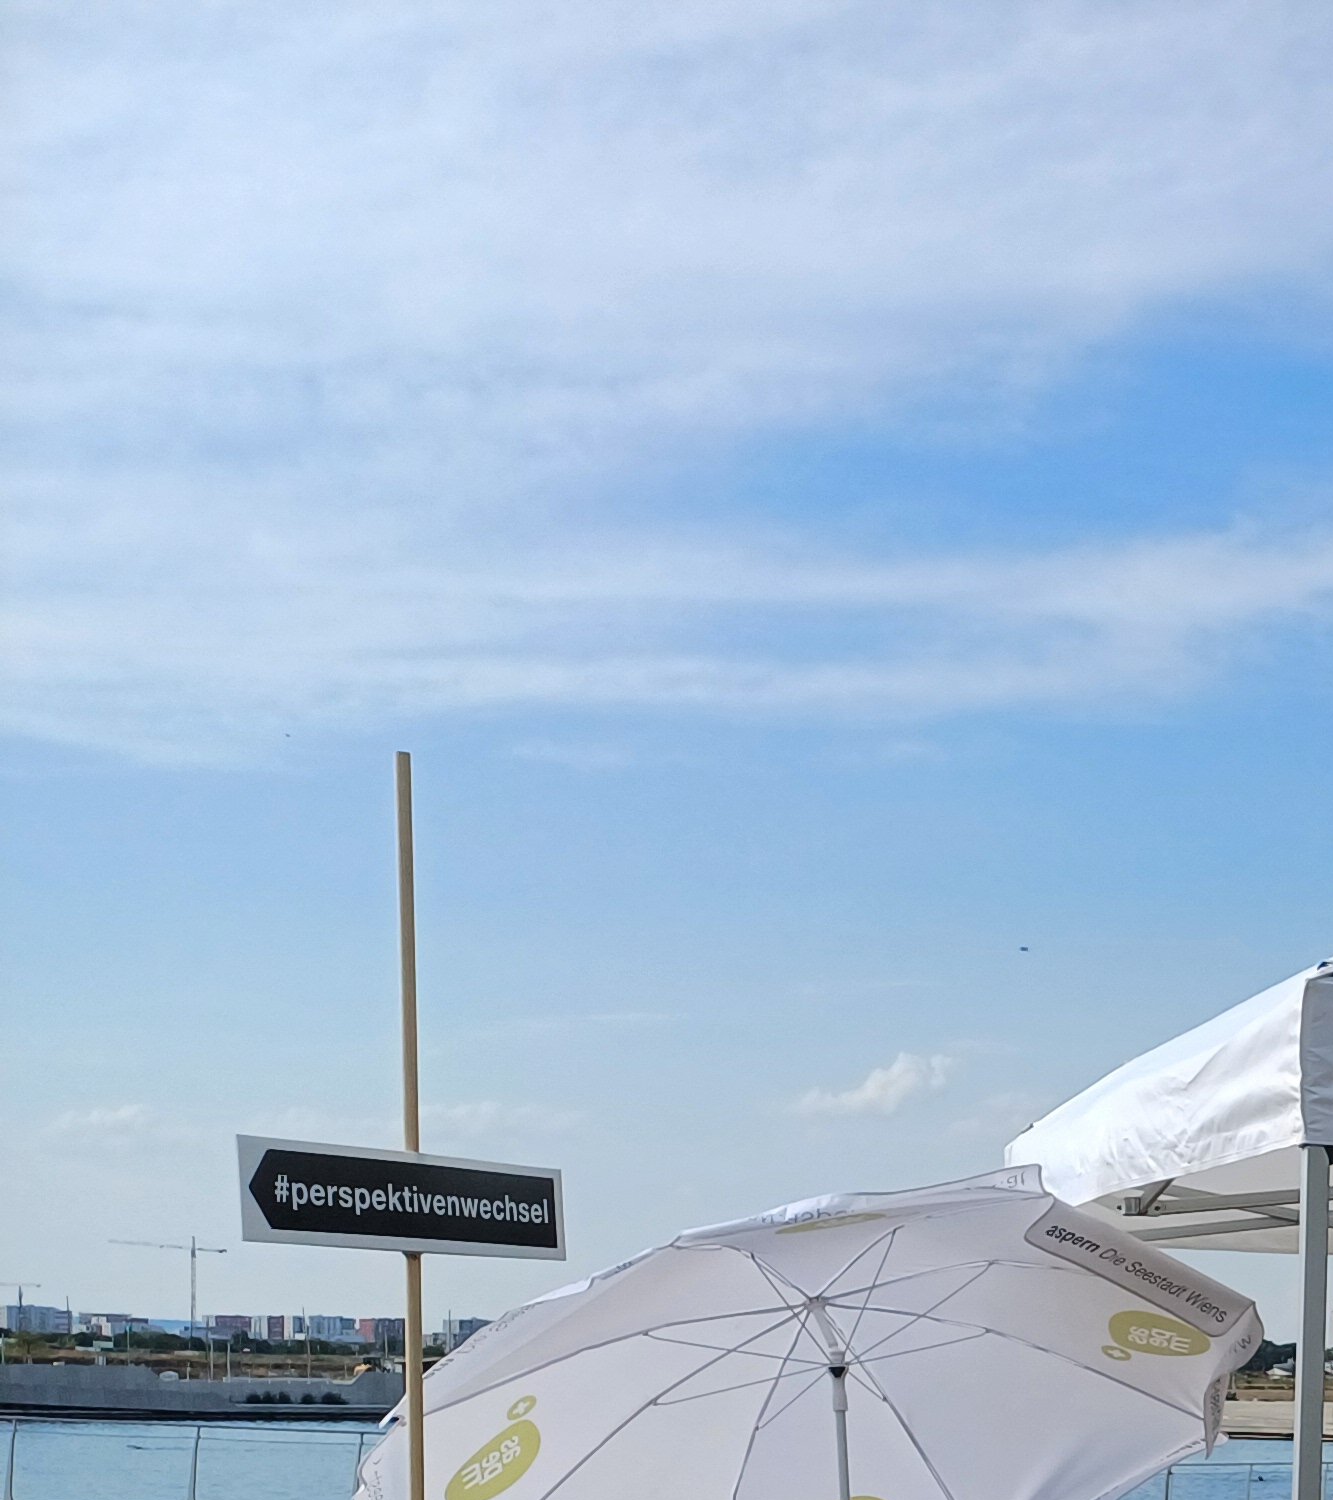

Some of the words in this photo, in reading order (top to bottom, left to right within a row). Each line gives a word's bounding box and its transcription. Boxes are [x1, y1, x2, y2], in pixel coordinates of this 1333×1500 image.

[274, 1174, 549, 1224] #perspektivenwechsel
[1045, 1224, 1100, 1254] aspern
[1099, 1248, 1126, 1266] Die
[1125, 1261, 1188, 1298] Seestadt
[1186, 1290, 1228, 1323] Wiens
